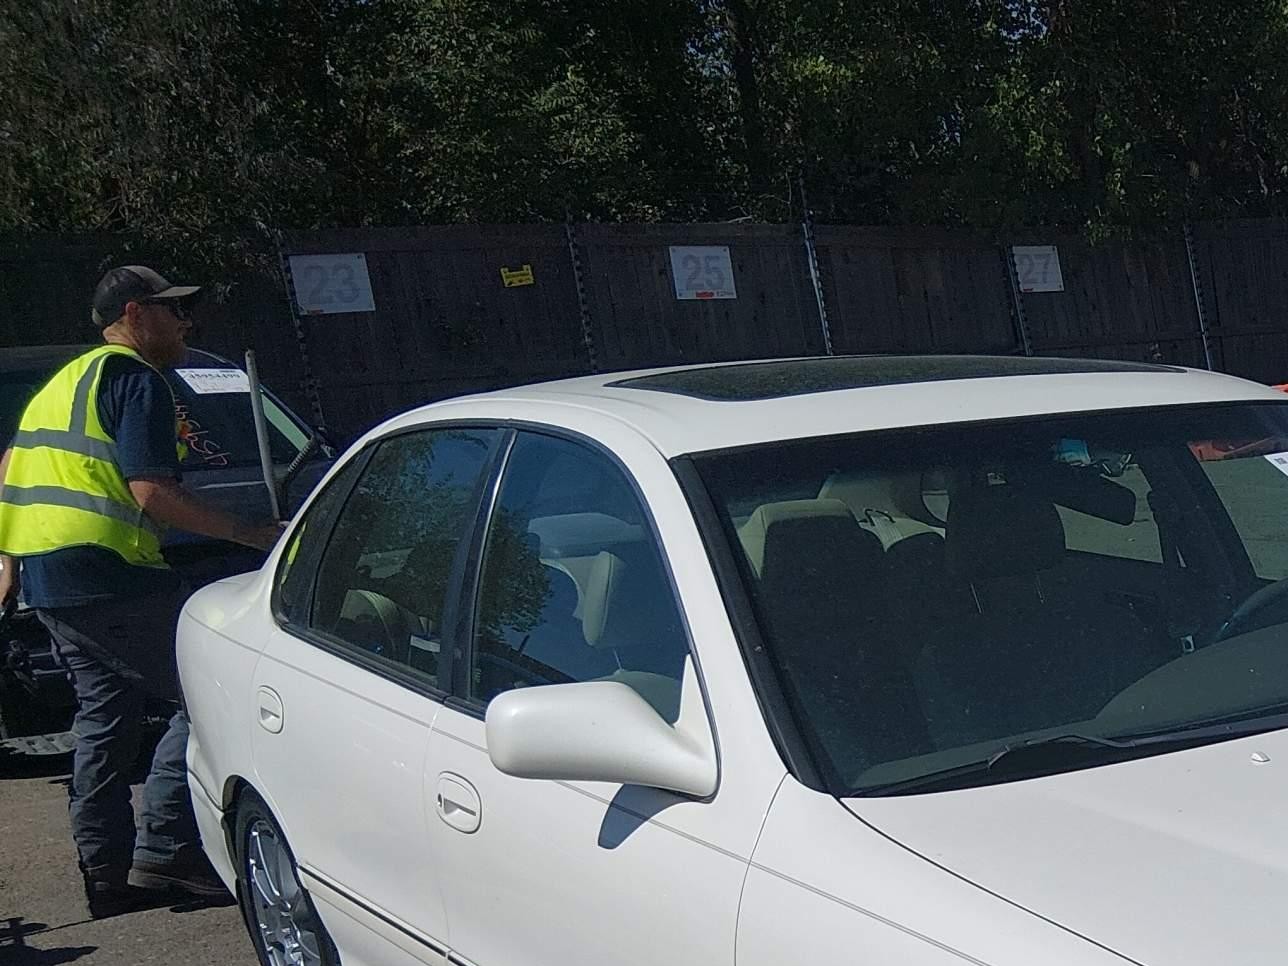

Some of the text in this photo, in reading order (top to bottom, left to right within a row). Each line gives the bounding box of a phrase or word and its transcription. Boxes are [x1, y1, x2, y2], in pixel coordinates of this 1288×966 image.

[303, 264, 360, 305] 23
[682, 253, 725, 291] 25
[1018, 253, 1051, 285] 27
